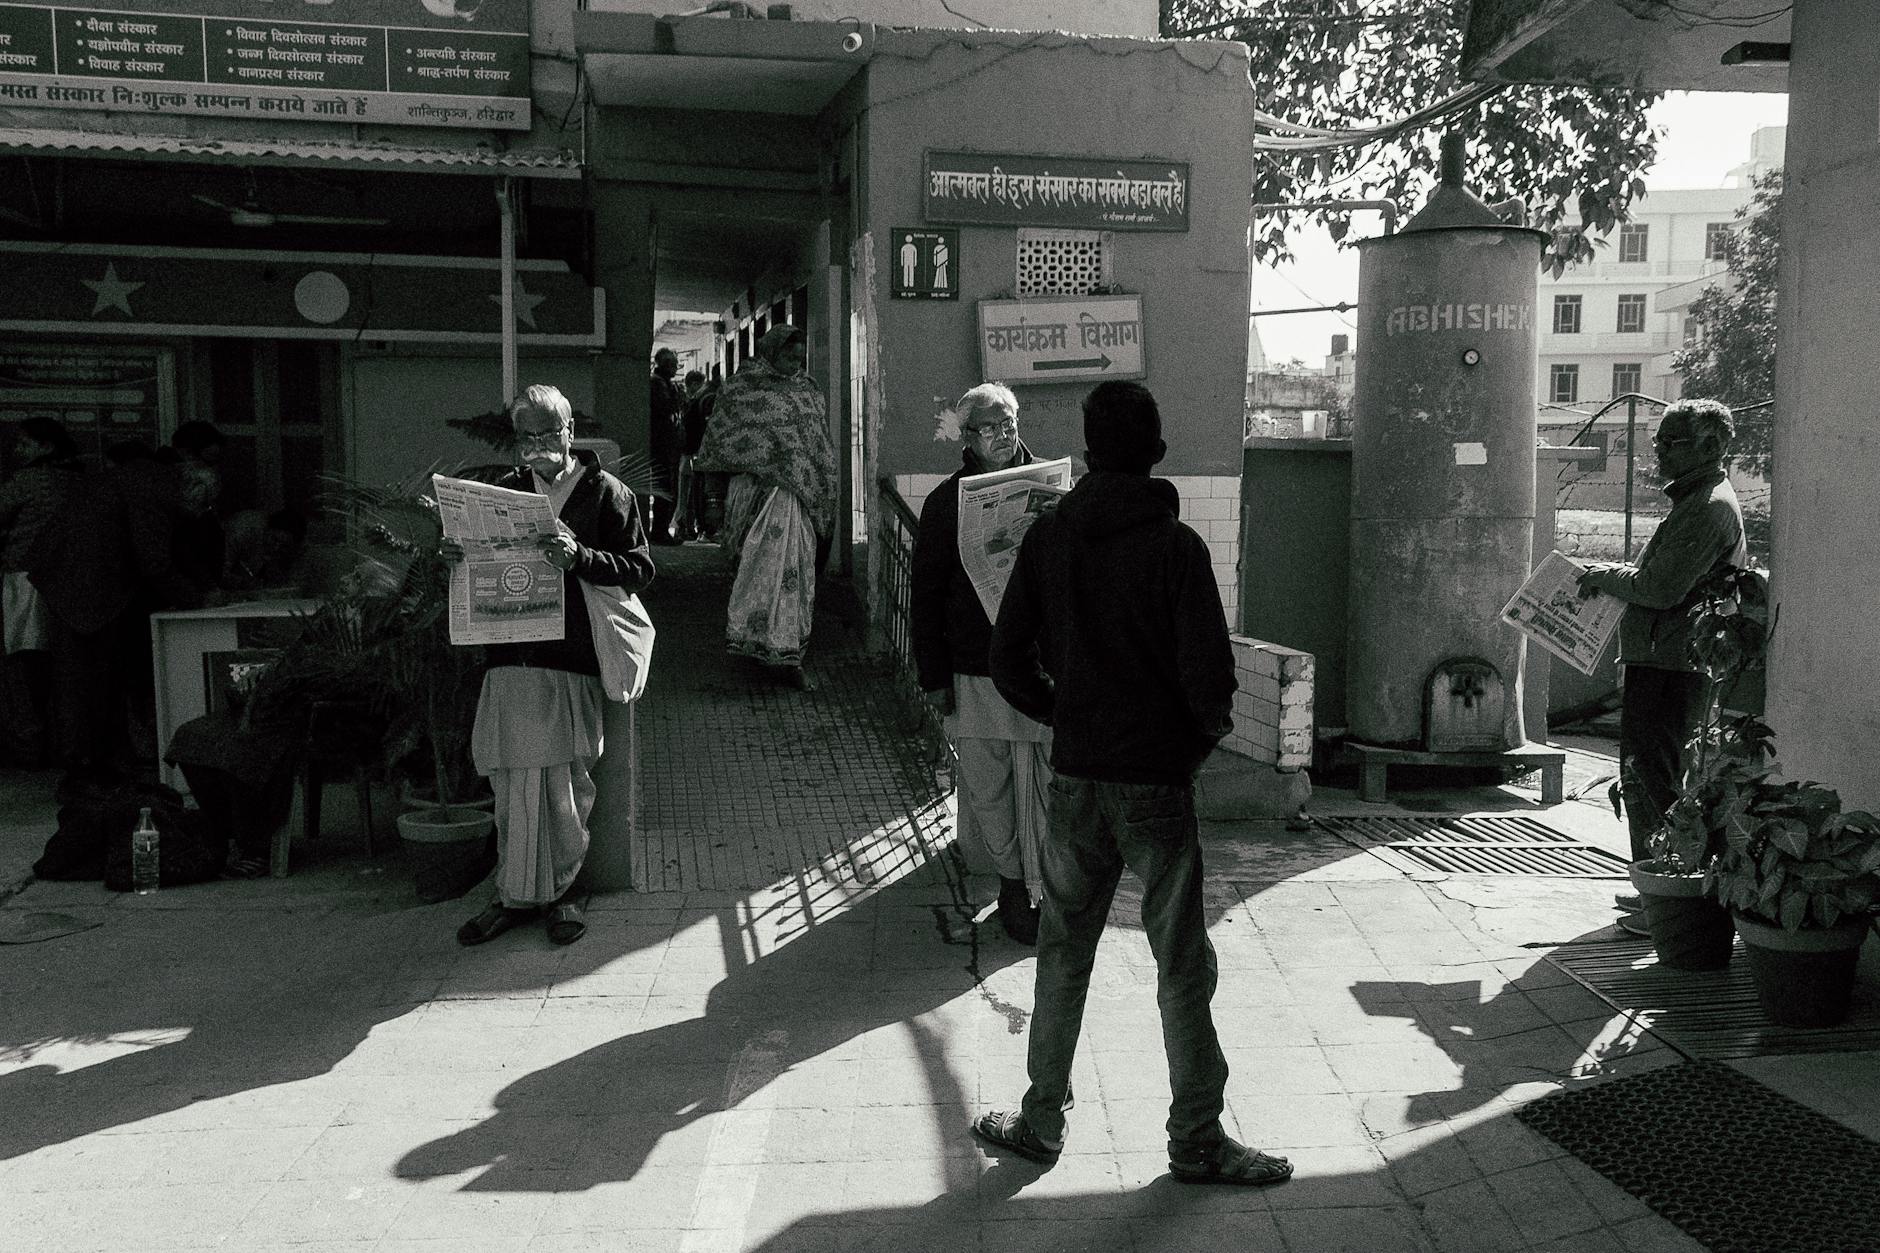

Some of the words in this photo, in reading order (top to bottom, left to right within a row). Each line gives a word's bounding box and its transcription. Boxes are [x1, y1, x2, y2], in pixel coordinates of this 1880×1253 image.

[87, 17, 113, 33] दीक्षा
[118, 20, 158, 35] संस्कार
[236, 26, 267, 41] विवाह
[271, 28, 325, 45] दिवसोत्सव
[329, 32, 368, 47] संस्कार
[88, 37, 140, 53] यज्ञोपवीत
[144, 40, 184, 55] संस्कार
[459, 48, 497, 61] संस्कार
[89, 55, 120, 71] विवाह
[125, 58, 164, 73] संस्कार
[237, 48, 263, 60] जन्म
[267, 47, 322, 63] दिवसोत्सव
[326, 50, 364, 65] संस्कार
[238, 67, 282, 79] वानप्रस्थ
[286, 67, 325, 81] संस्कार
[473, 66, 511, 81] संस्कार
[0, 83, 38, 100] मस्त
[46, 82, 105, 103] संस्कार
[193, 93, 251, 111] सम्पन्न
[258, 94, 305, 112] कराये
[313, 96, 348, 115] जाते
[351, 97, 368, 116] हैं
[930, 170, 991, 205] आत्मबल
[991, 166, 1007, 205] ही
[1007, 174, 1035, 209] इस
[1036, 171, 1079, 208] संसार
[1078, 178, 1098, 204] का
[1098, 170, 1131, 208] सबसे
[1130, 180, 1152, 210] बड़ा
[1152, 181, 1173, 215] बल
[1386, 303, 1531, 337] ABHISHEK
[985, 316, 1068, 352] कार्यक्रम
[1076, 312, 1139, 349] विभाग
